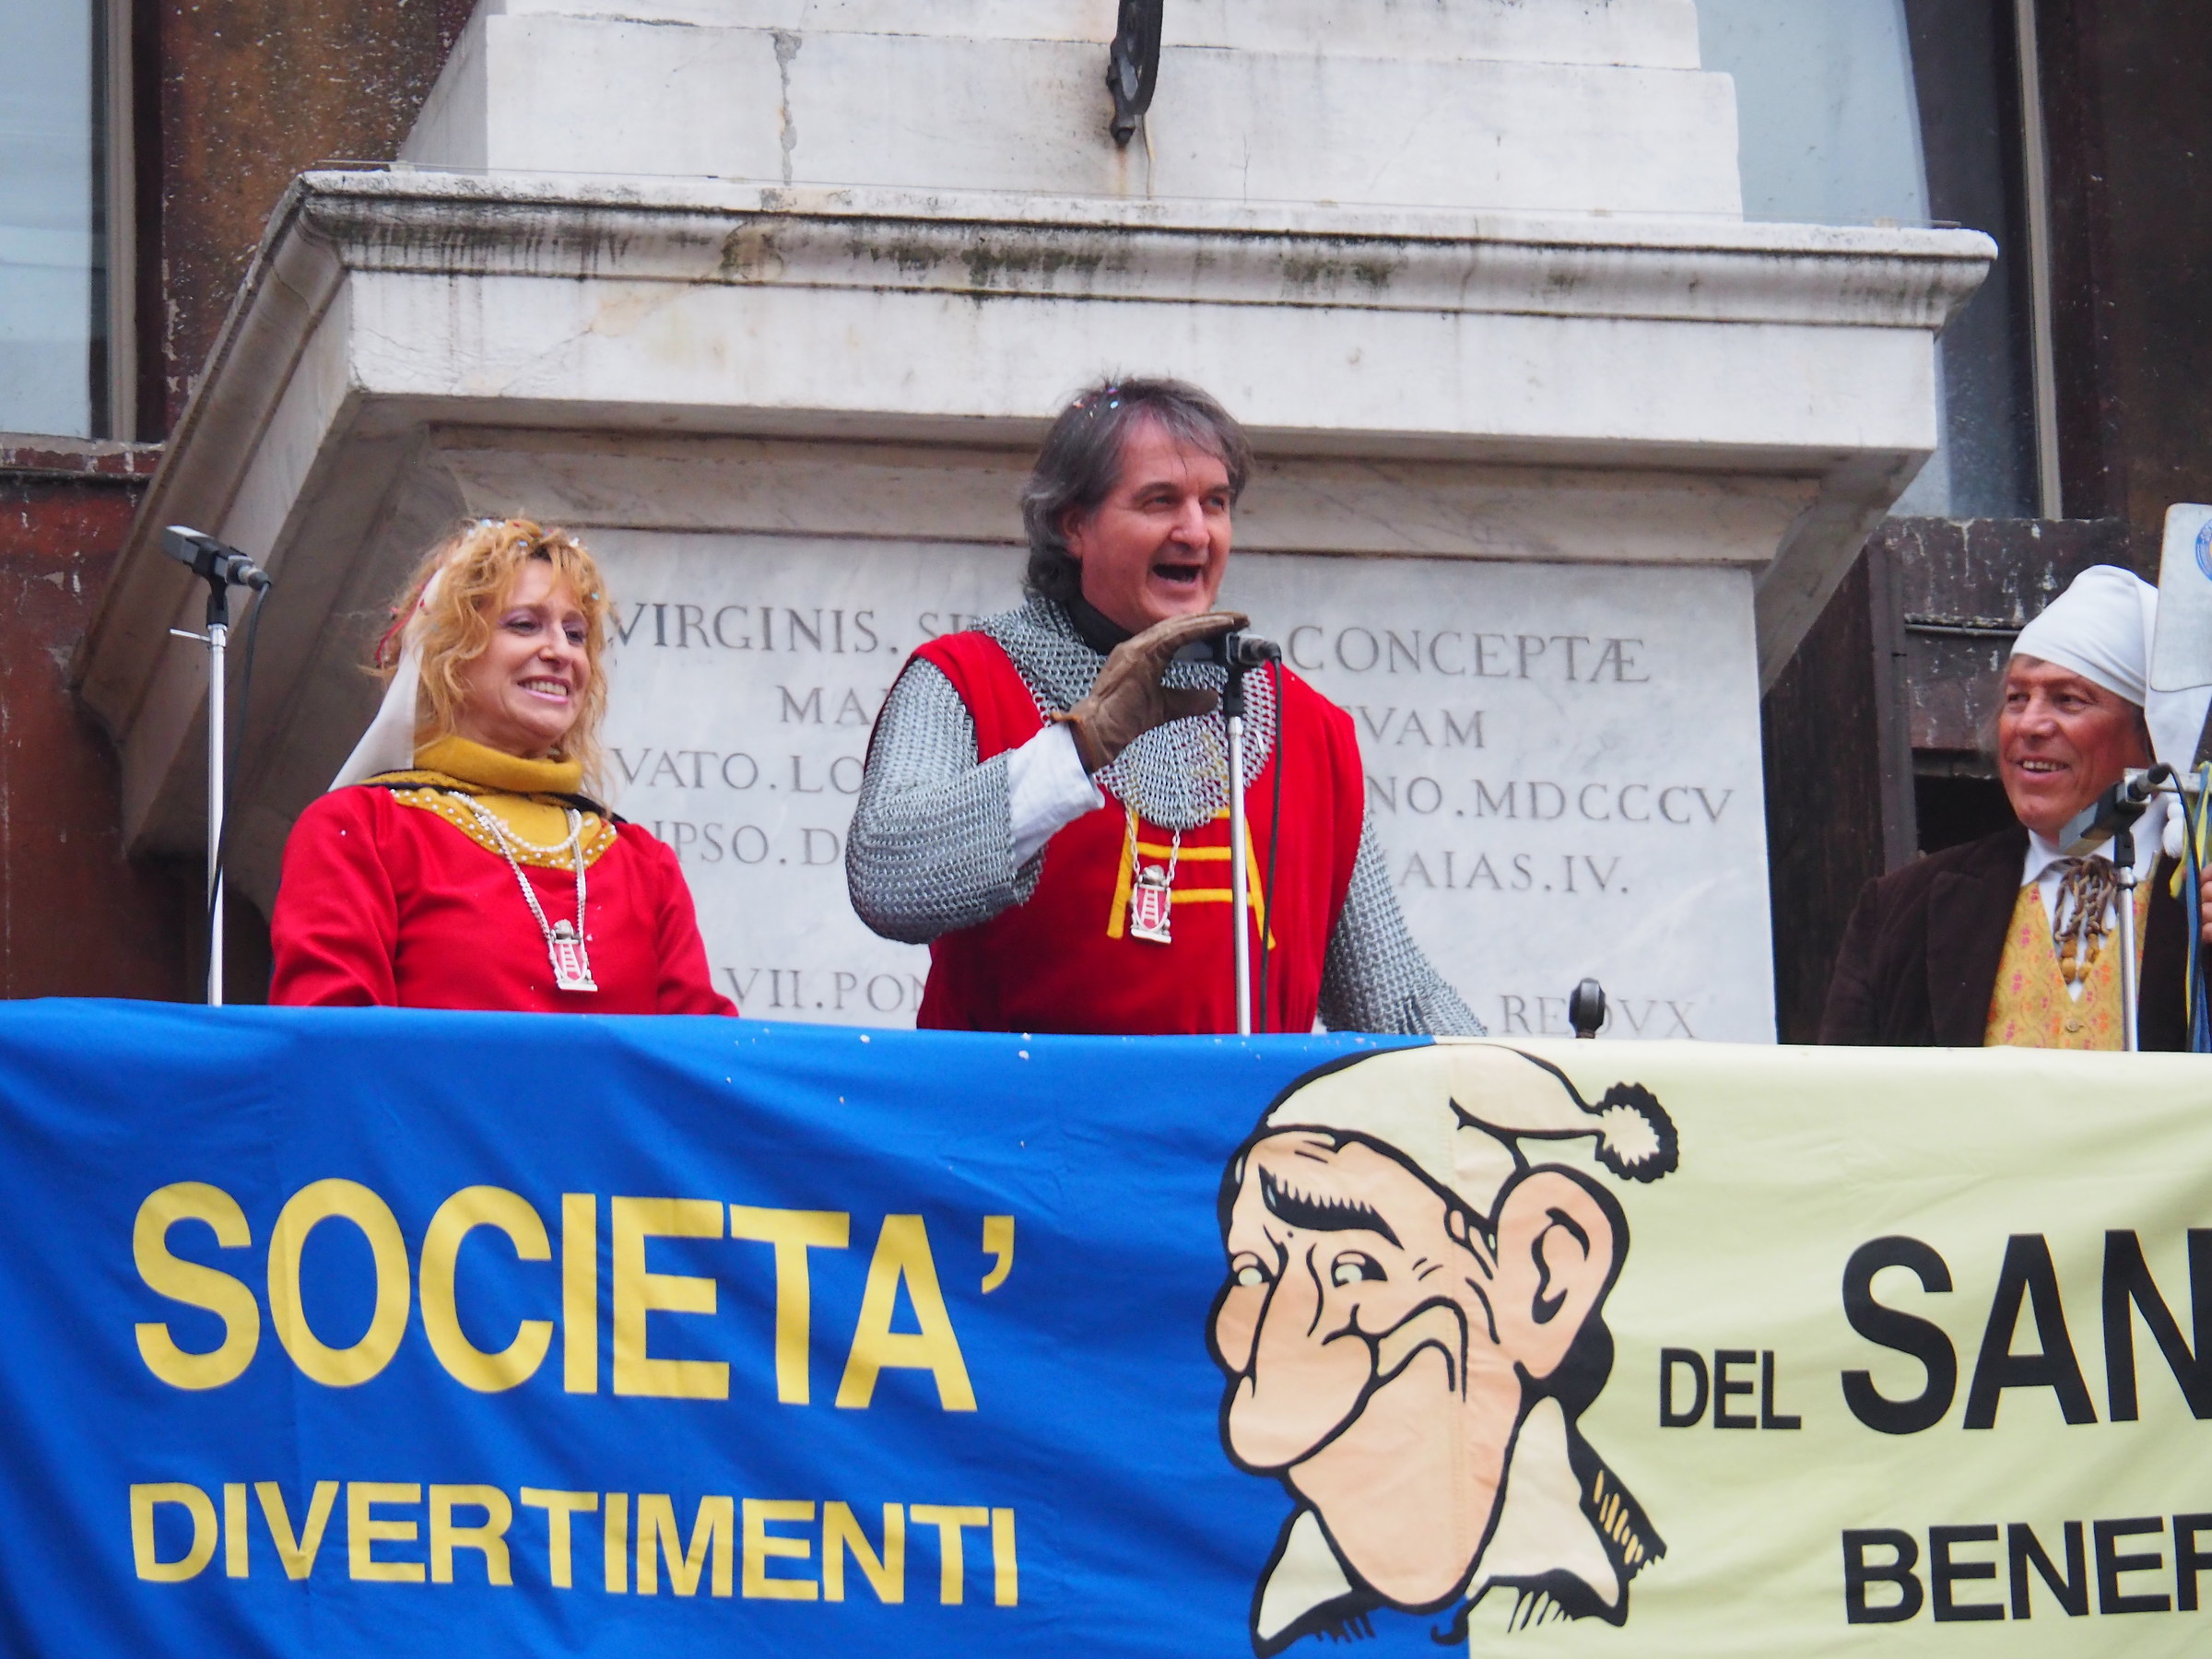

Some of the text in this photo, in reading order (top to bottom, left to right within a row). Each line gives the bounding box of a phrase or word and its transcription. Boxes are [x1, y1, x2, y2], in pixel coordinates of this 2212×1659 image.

[776, 685, 892, 726] MA
[1340, 705, 1487, 748] VAM
[133, 1177, 1016, 1412] SOCIETA'
[1659, 1227, 2212, 1435] DEL SAN
[128, 1480, 1019, 1607] DIVERTIMENTI
